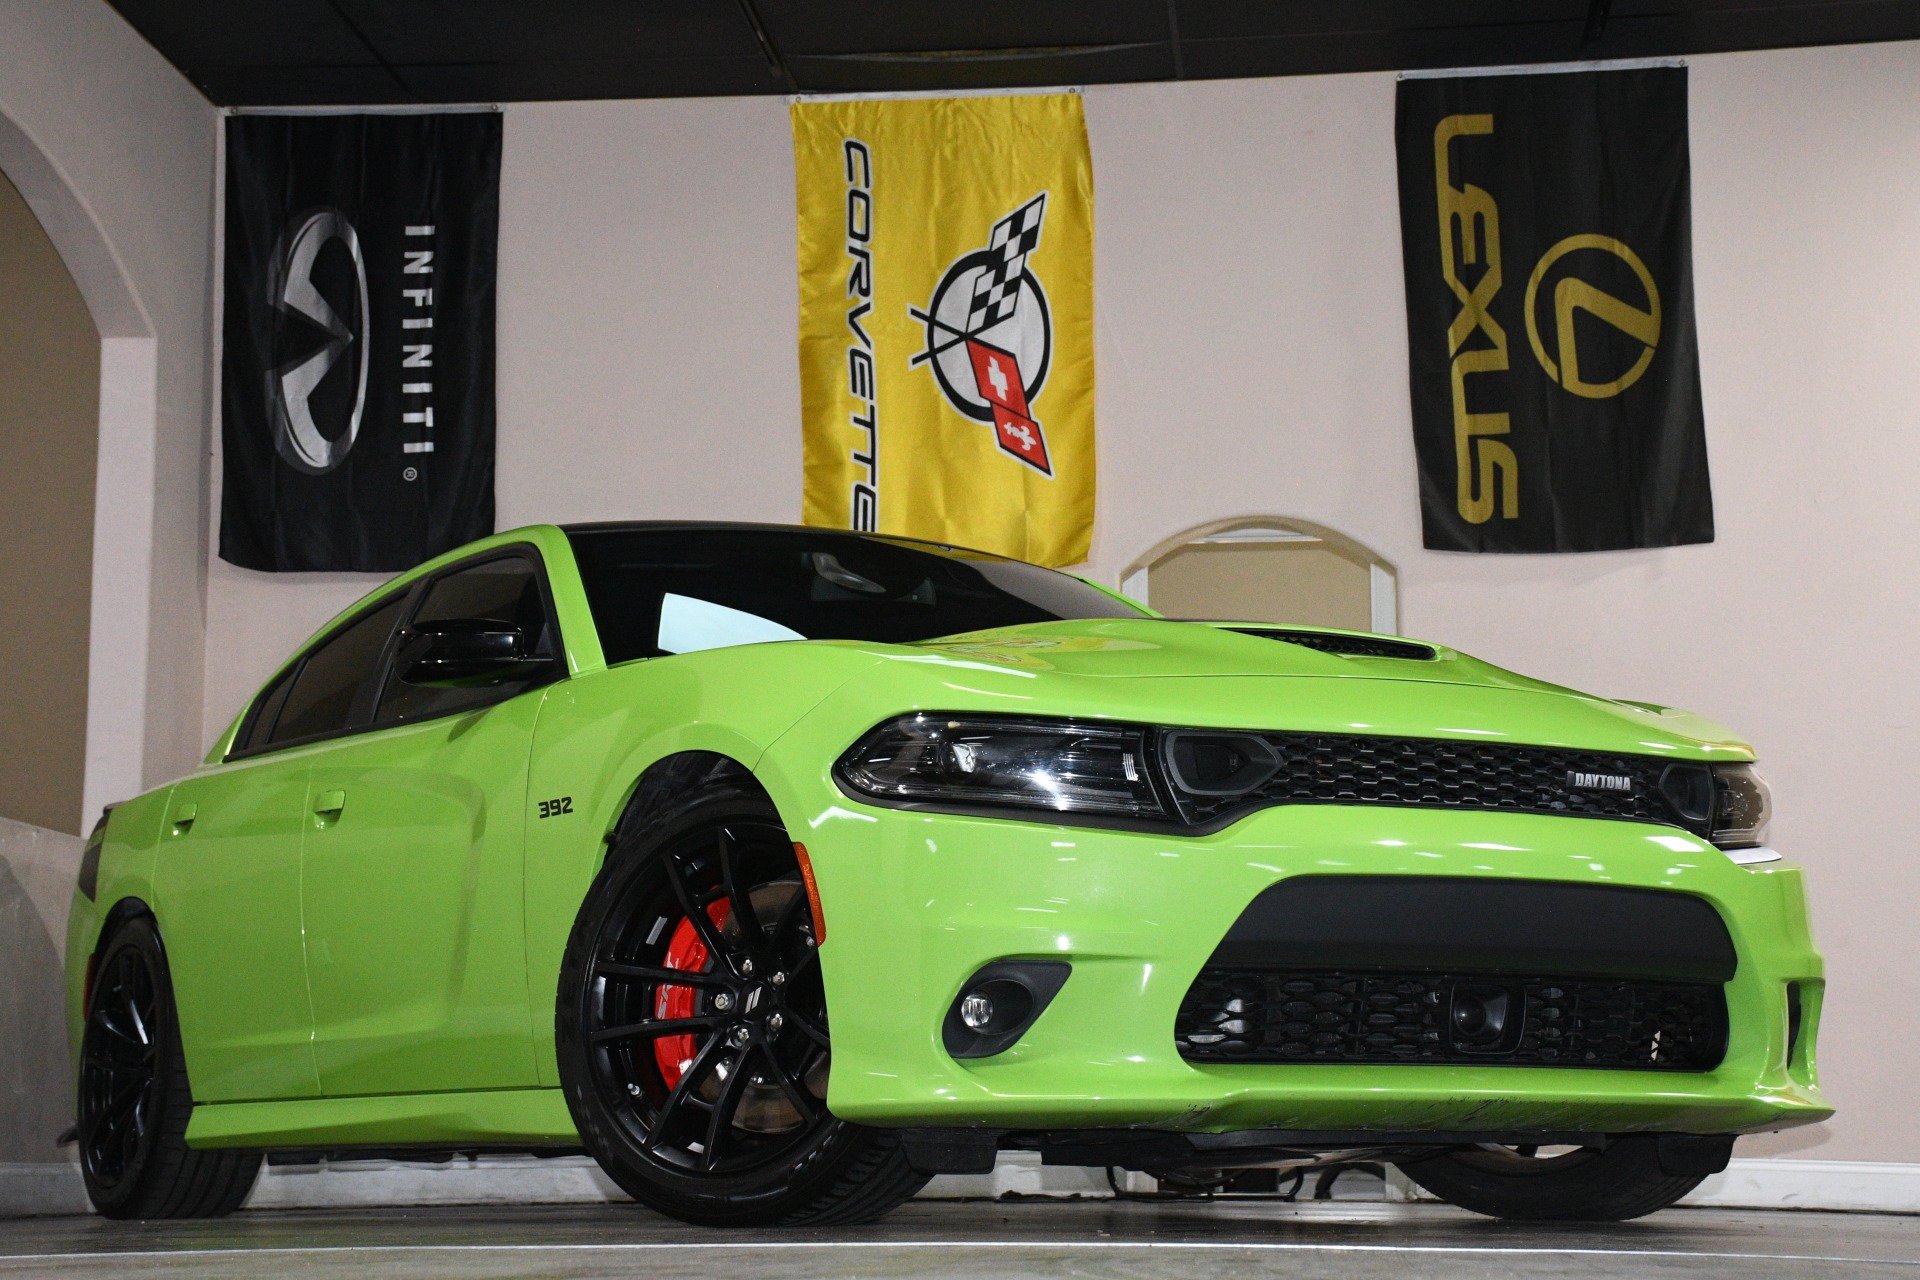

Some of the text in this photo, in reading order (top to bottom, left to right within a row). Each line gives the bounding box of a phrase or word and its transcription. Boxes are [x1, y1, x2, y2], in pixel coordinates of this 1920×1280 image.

[402, 225, 435, 453] INFINITI
[844, 138, 878, 532] CORVETTE
[1434, 113, 1519, 524] LEXUS
[538, 796, 573, 819] 392
[1574, 772, 1631, 791] DAYTONA
